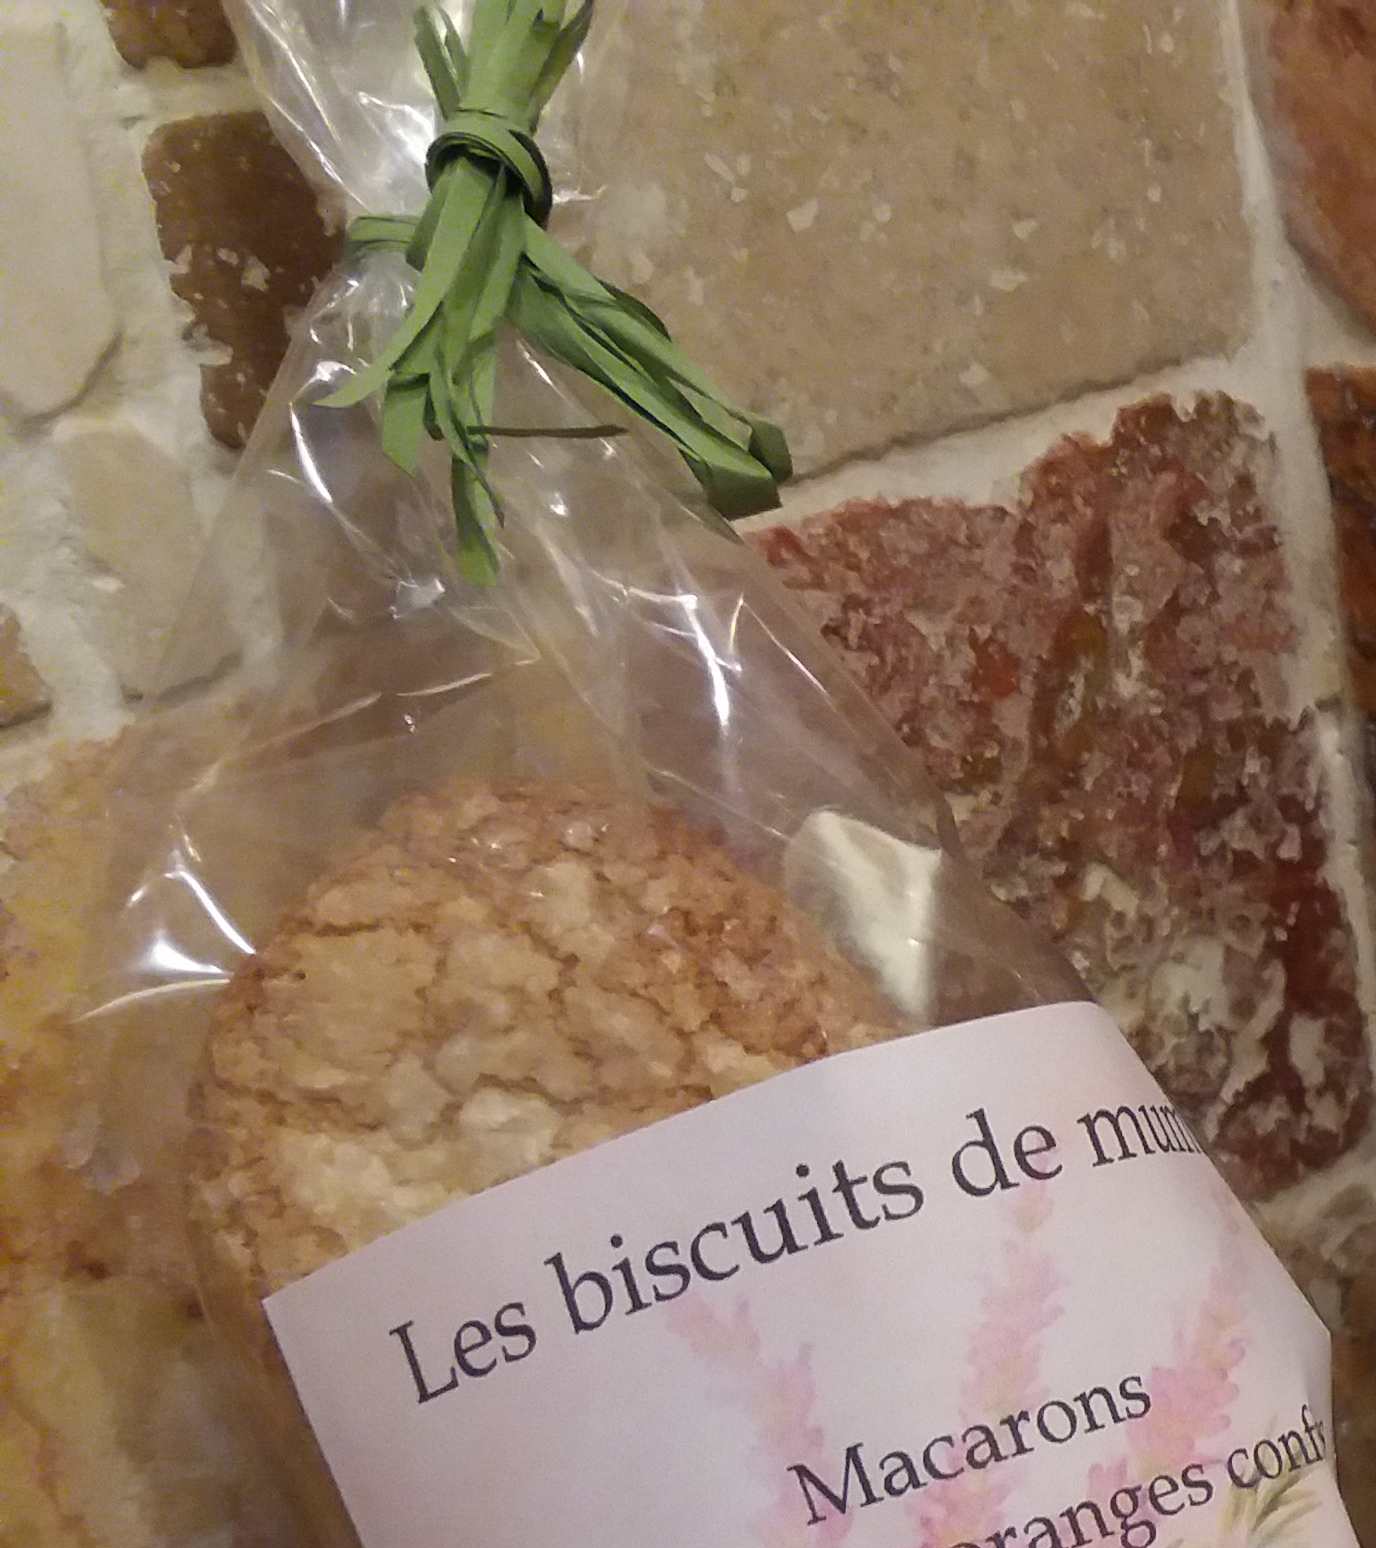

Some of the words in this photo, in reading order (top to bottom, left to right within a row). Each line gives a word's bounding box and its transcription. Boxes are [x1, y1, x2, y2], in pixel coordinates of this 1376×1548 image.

[389, 1303, 536, 1404] Les
[544, 1160, 923, 1334] biscuits
[952, 1108, 1062, 1196] de
[787, 1377, 1151, 1525] Macarons
